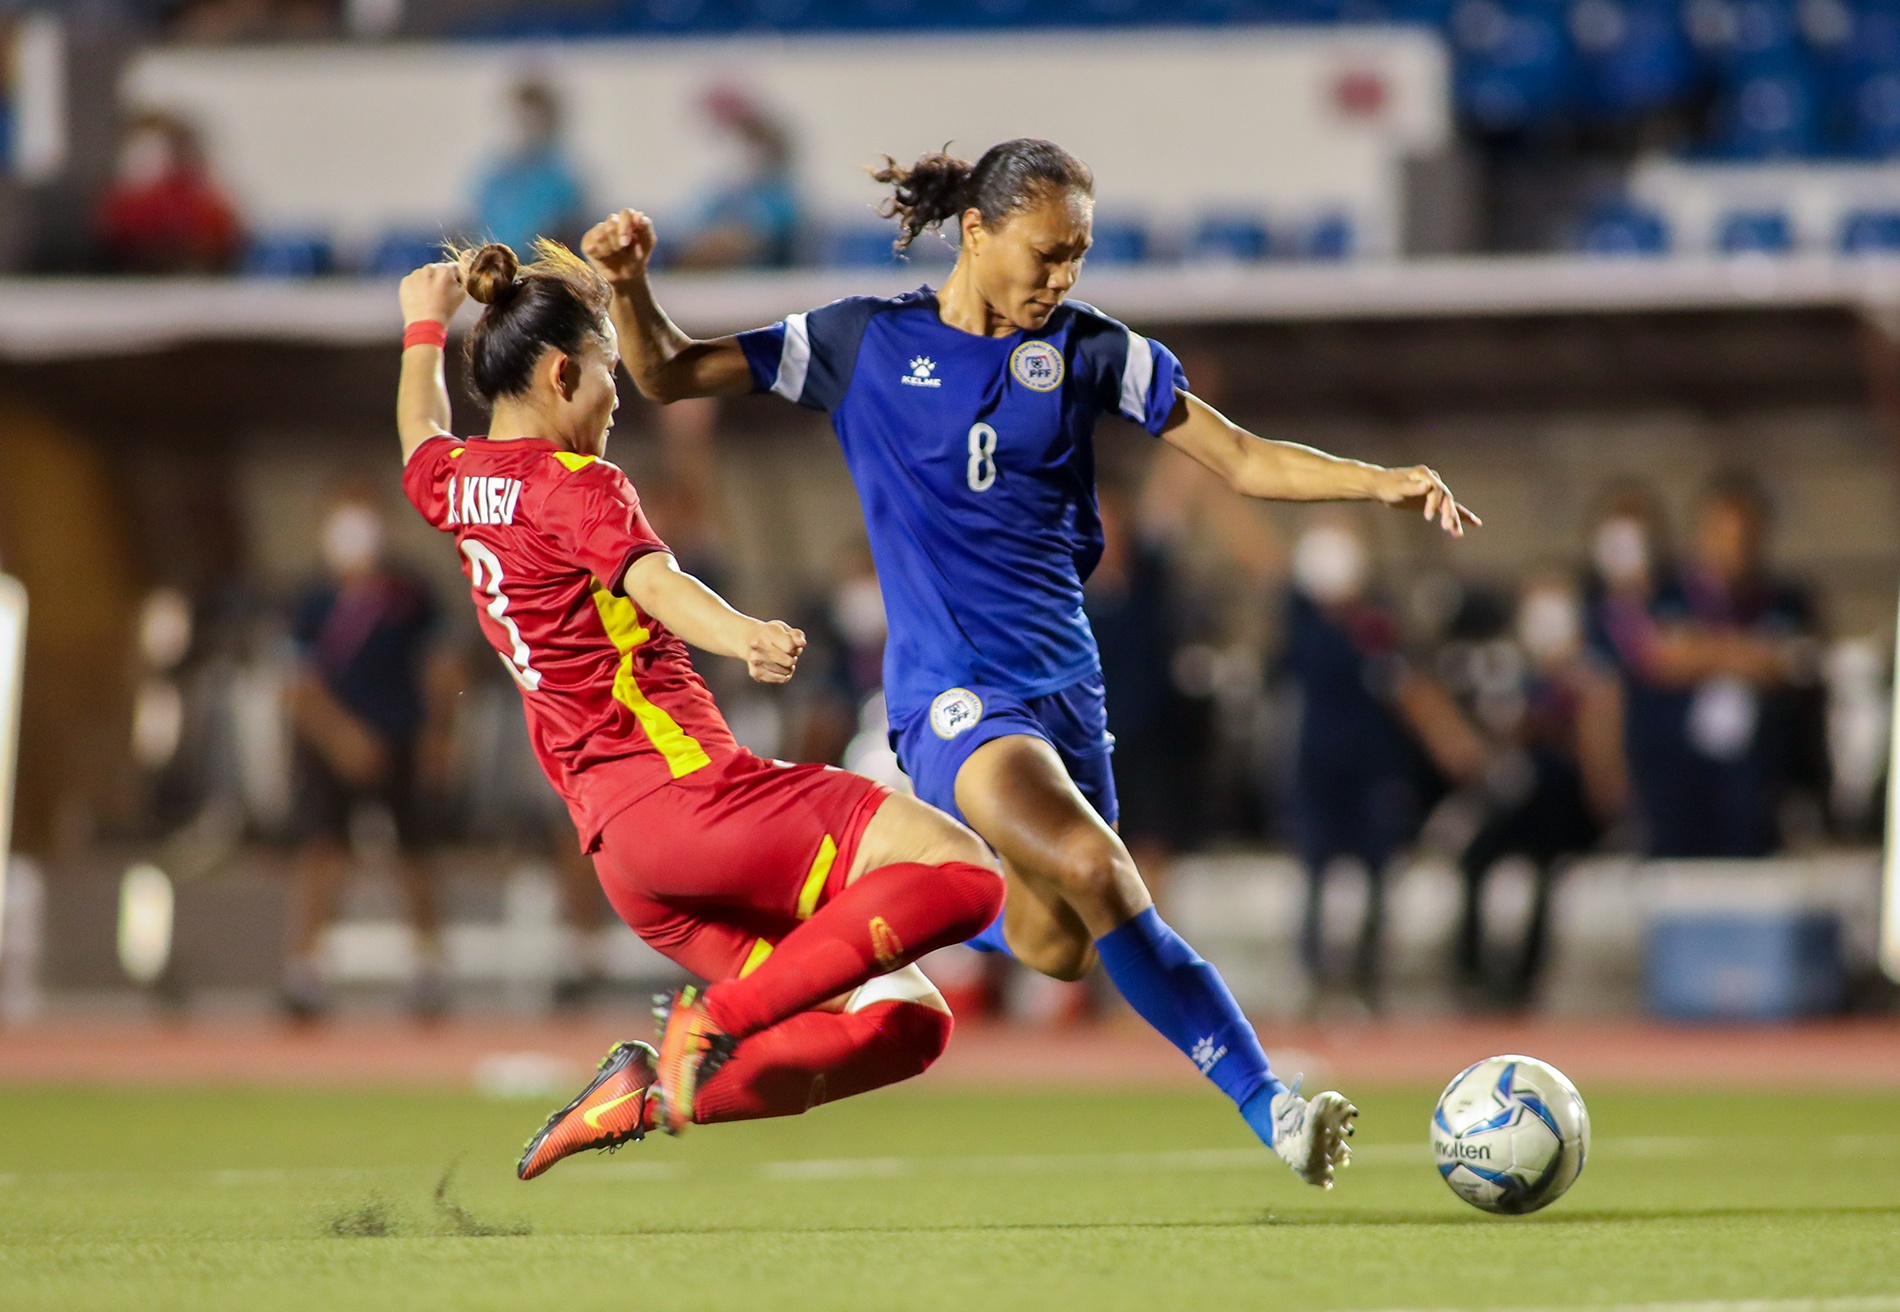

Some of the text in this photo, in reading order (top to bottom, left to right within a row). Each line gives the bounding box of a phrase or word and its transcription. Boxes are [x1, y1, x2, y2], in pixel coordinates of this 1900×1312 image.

[901, 375, 942, 388] KELME
[1029, 369, 1051, 378] PFF
[967, 422, 997, 492] 8
[460, 538, 542, 692] 3
[950, 709, 970, 726] PFF
